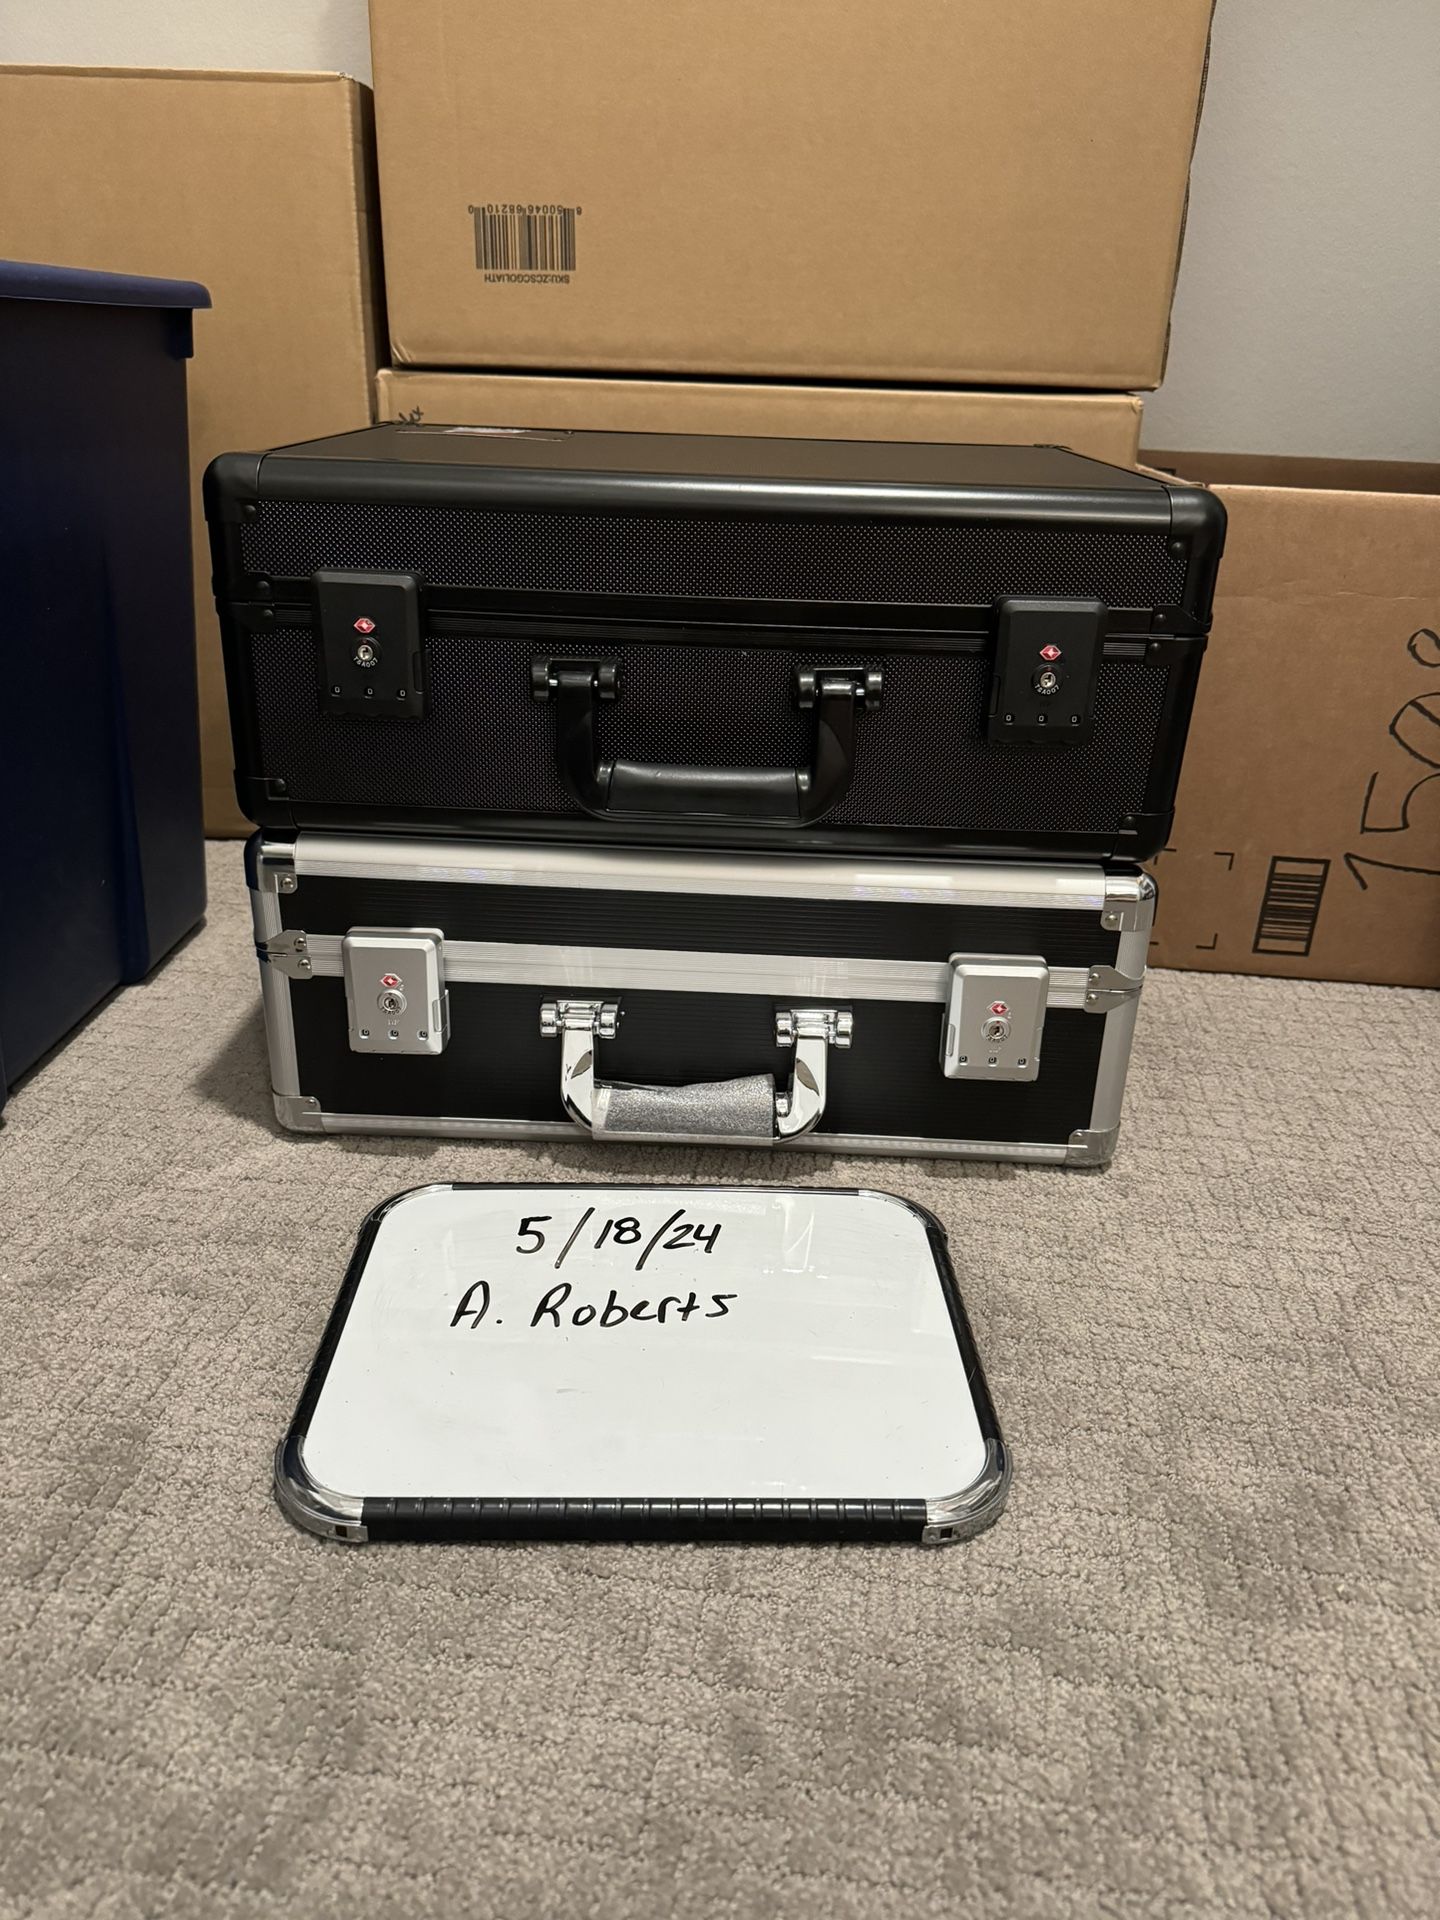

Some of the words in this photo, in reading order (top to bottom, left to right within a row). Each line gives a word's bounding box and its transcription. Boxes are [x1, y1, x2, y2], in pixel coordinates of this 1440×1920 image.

[467, 204, 474, 215] 0
[486, 203, 523, 215] 68210
[527, 204, 563, 215] 50046
[576, 206, 583, 216] 8
[484, 273, 570, 285] SKU:ZCSCGOLIATH
[354, 655, 379, 669] TSA007
[1034, 683, 1060, 696] TSA007
[515, 1206, 722, 1271] 5/18/24
[449, 1279, 504, 1330] A.
[529, 1281, 739, 1328] Roberts
